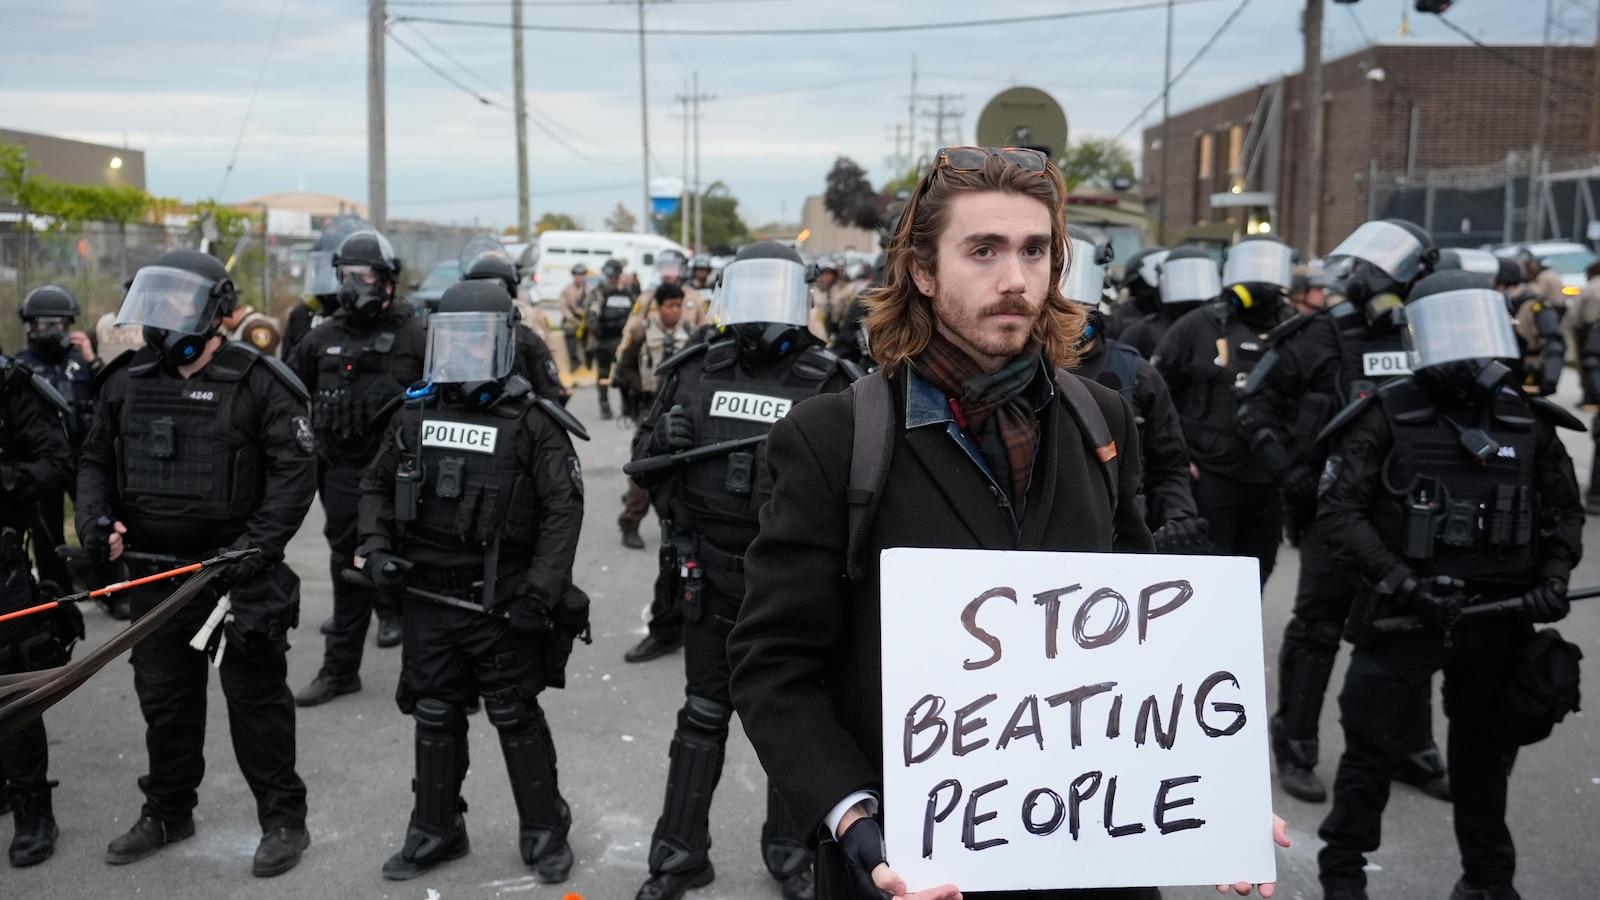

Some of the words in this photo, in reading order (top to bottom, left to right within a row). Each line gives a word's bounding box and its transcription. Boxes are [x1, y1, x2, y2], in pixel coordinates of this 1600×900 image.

[1369, 356, 1409, 370] POL
[190, 390, 214, 401] 4240
[714, 395, 787, 419] POLICE
[423, 424, 492, 447] POLICE
[960, 579, 1194, 671] STOP
[903, 670, 1247, 768] BEATING
[921, 770, 1207, 860] PEOPLE
